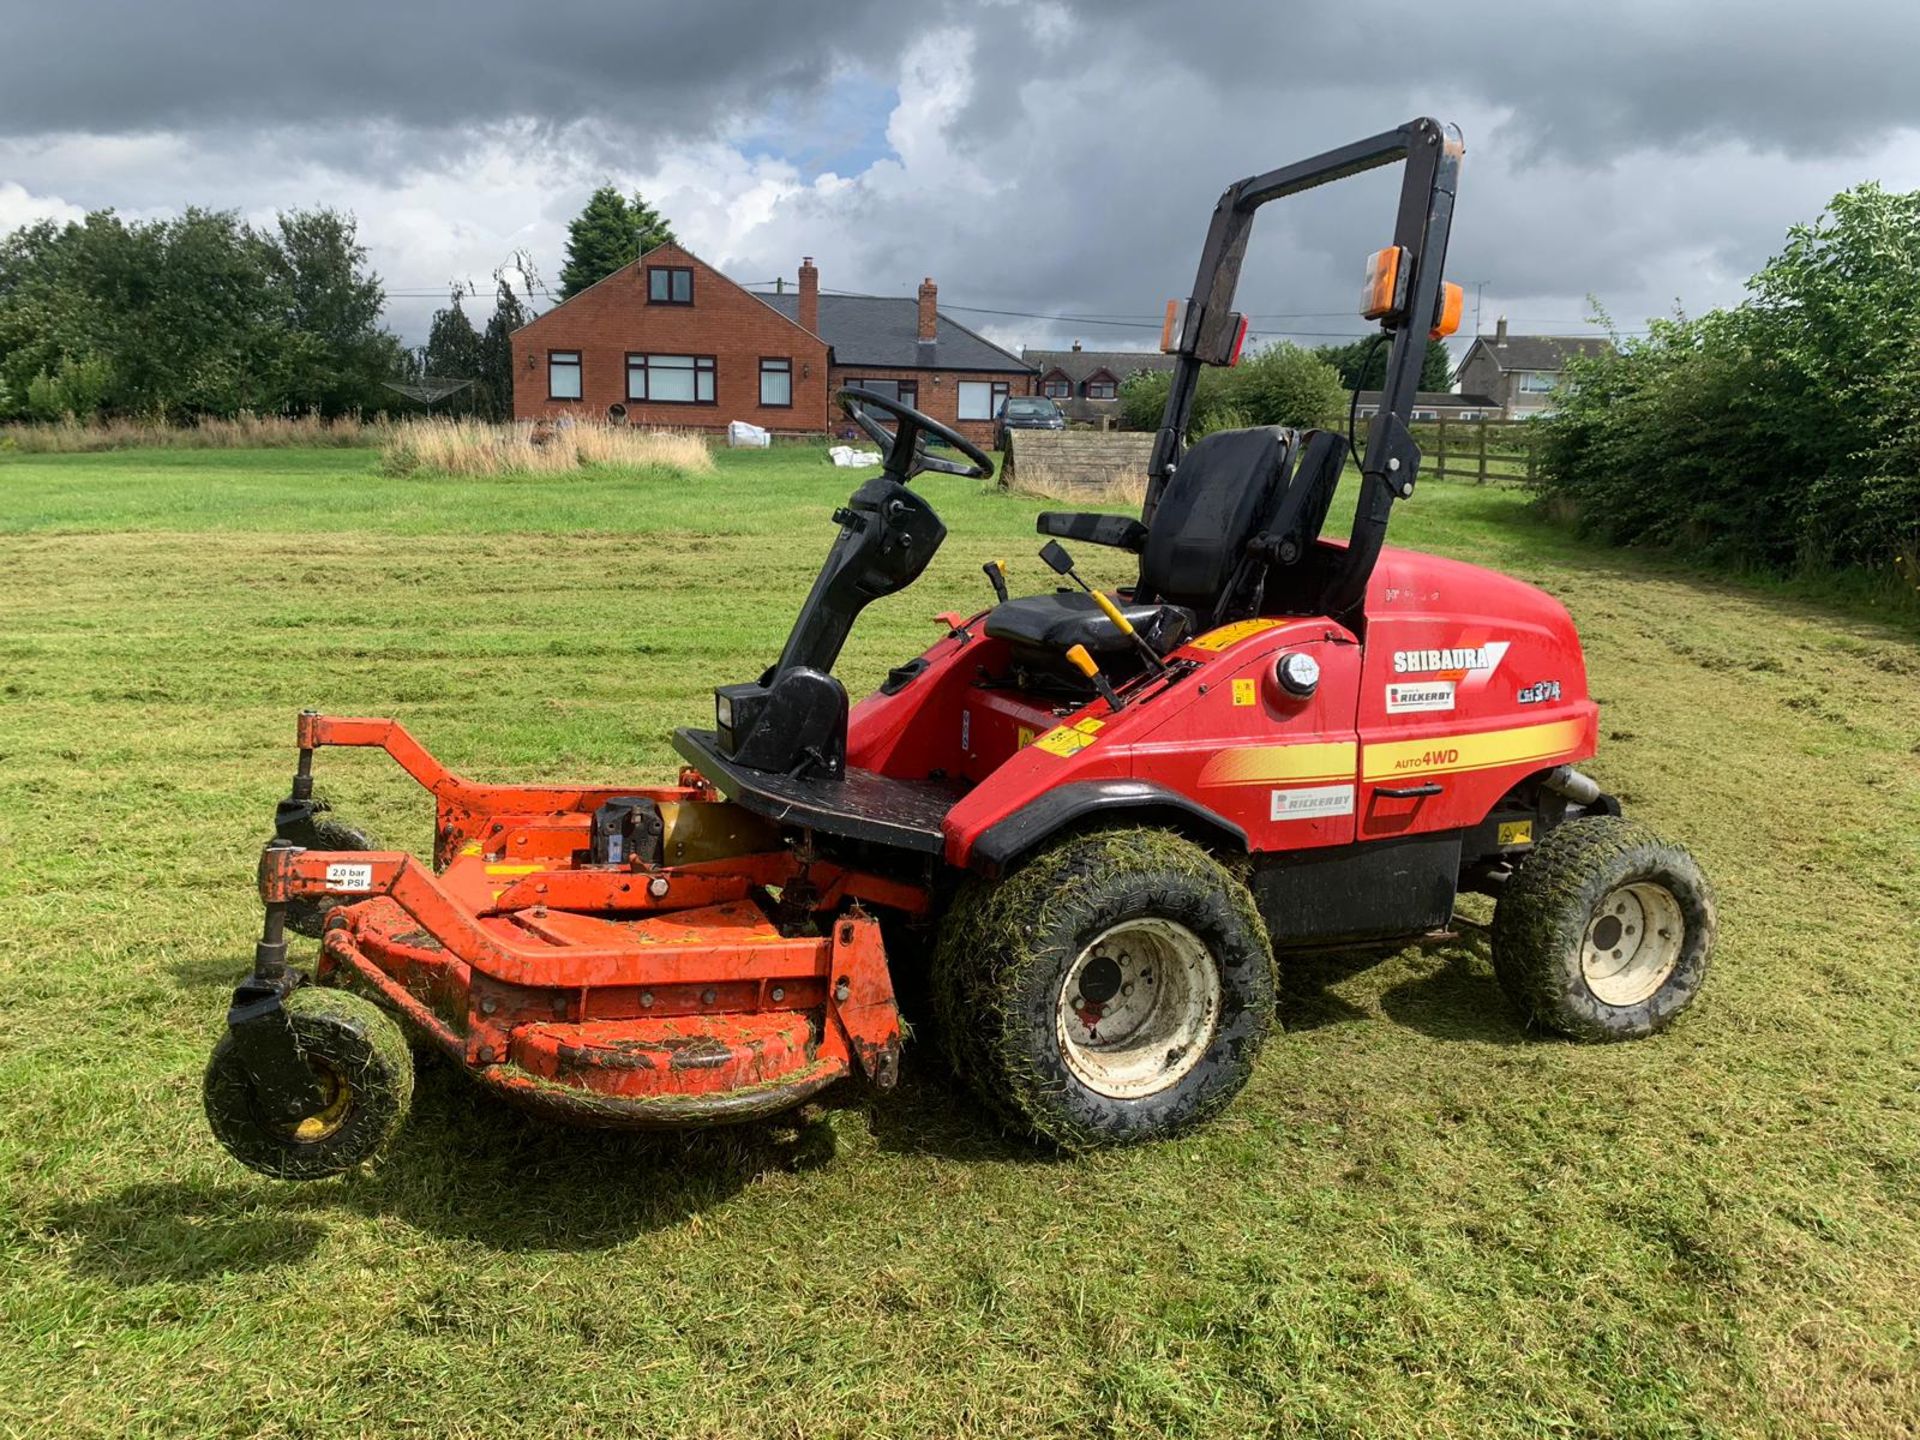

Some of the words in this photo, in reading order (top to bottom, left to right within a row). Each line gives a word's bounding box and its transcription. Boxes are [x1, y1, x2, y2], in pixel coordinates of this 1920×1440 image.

[1393, 646, 1489, 673] SHIBAURA
[1400, 691, 1451, 703] RICKERBY
[1289, 795, 1350, 809] RICKERBY
[333, 868, 346, 877] 2.0
[349, 868, 365, 877] bar
[347, 879, 364, 887] PSI
